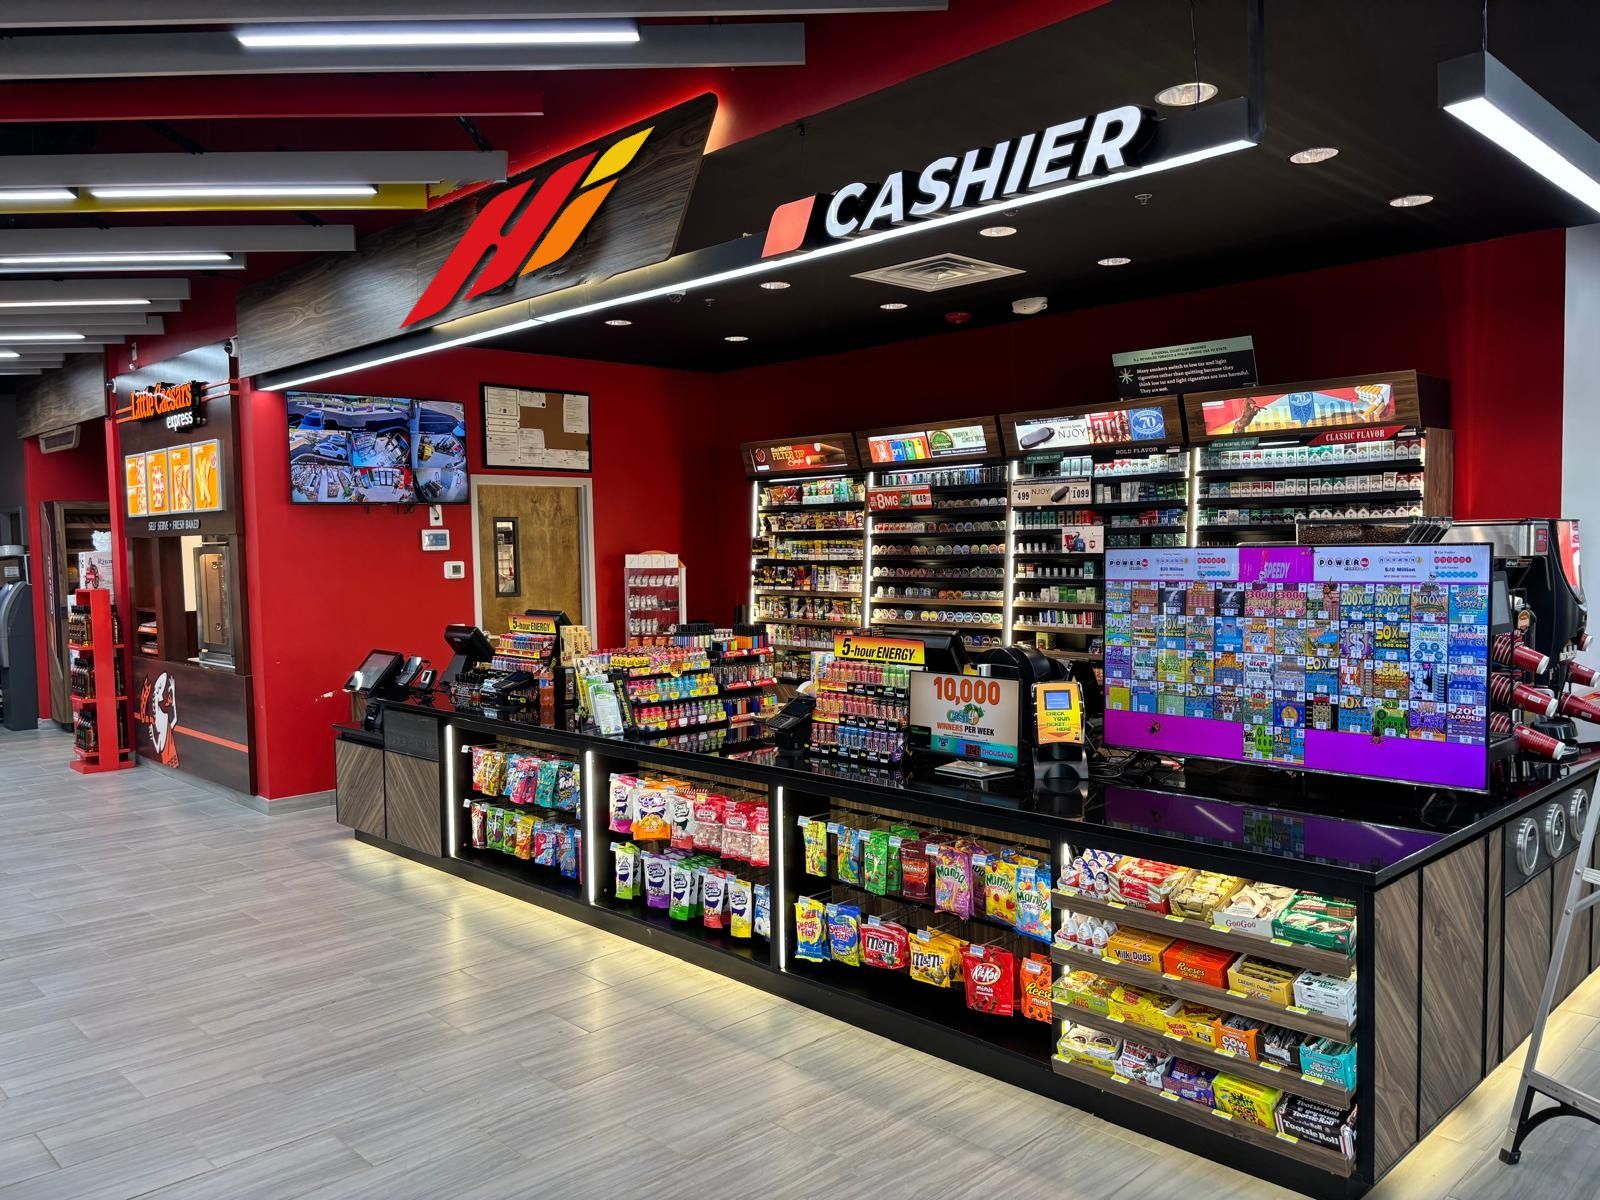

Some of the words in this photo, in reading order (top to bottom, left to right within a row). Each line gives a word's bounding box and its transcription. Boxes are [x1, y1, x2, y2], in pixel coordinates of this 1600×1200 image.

[825, 105, 1141, 238] CASHIER
[130, 389, 155, 419] Little
[154, 382, 192, 414] Caesars
[166, 411, 194, 431] express
[1139, 416, 1156, 428] 70
[1058, 428, 1086, 440] NJOY
[1325, 431, 1355, 442] CLASSIC
[1356, 429, 1385, 440] FLAVOR
[771, 451, 794, 461] FILTER
[1133, 446, 1158, 454] FLAVOR
[876, 493, 899, 509] 8MG
[1017, 491, 1030, 501] 499
[1031, 487, 1050, 496] NJOY
[148, 521, 157, 531] SELF
[157, 520, 169, 531] SERVE
[172, 520, 185, 530] FRESH
[185, 519, 200, 529] BAKED
[1264, 560, 1291, 579] SPEEDY
[1341, 592, 1364, 606] 200X
[1376, 592, 1400, 606] 200X
[531, 622, 551, 632] ENERGY
[1375, 625, 1398, 640] 50X
[842, 637, 876, 658] 5-hour
[876, 646, 916, 660] ENERGY
[1341, 666, 1358, 674] FIERY
[933, 676, 1001, 706] 10,000
[1451, 714, 1482, 722] LOADED
[936, 722, 964, 733] WINNERS
[964, 725, 976, 735] PER
[977, 727, 995, 737] WEEK
[981, 748, 1014, 760] THOUSAND
[936, 864, 966, 884] Mamba
[986, 873, 1014, 893] Mamba
[1016, 892, 1048, 911] Mamba
[801, 928, 816, 939] Fish
[828, 924, 854, 938] Swedish
[835, 931, 850, 942] Fish
[1115, 949, 1131, 960] Milk
[1132, 951, 1152, 962] Duds
[1302, 976, 1338, 987] Junior
[976, 985, 994, 993] minis
[1031, 998, 1049, 1007] minis
[1221, 1035, 1248, 1048] COW
[1323, 1073, 1344, 1085] TALES
[1296, 1099, 1324, 1112] Tootsie
[1323, 1107, 1340, 1117] Roll
[1292, 1110, 1320, 1123] Tootsie
[1320, 1116, 1335, 1126] Roll
[1283, 1119, 1318, 1138] Tootsie
[1318, 1132, 1339, 1145] Roll
